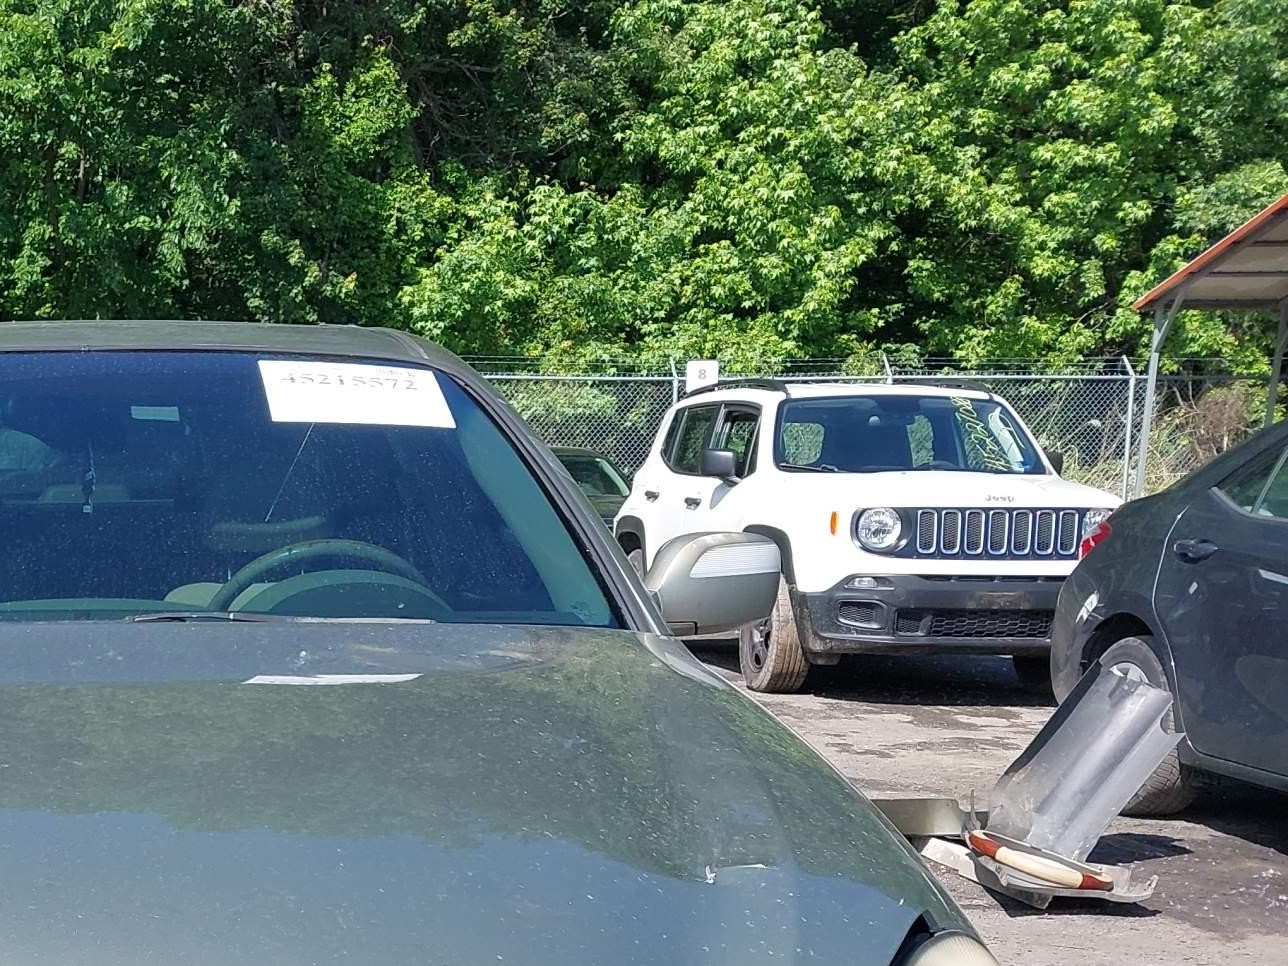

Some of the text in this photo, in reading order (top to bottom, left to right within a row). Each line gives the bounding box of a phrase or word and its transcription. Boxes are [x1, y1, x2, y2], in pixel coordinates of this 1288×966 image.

[698, 369, 706, 380] 8
[281, 373, 417, 391] 45215572
[985, 494, 1015, 503] Jeep
